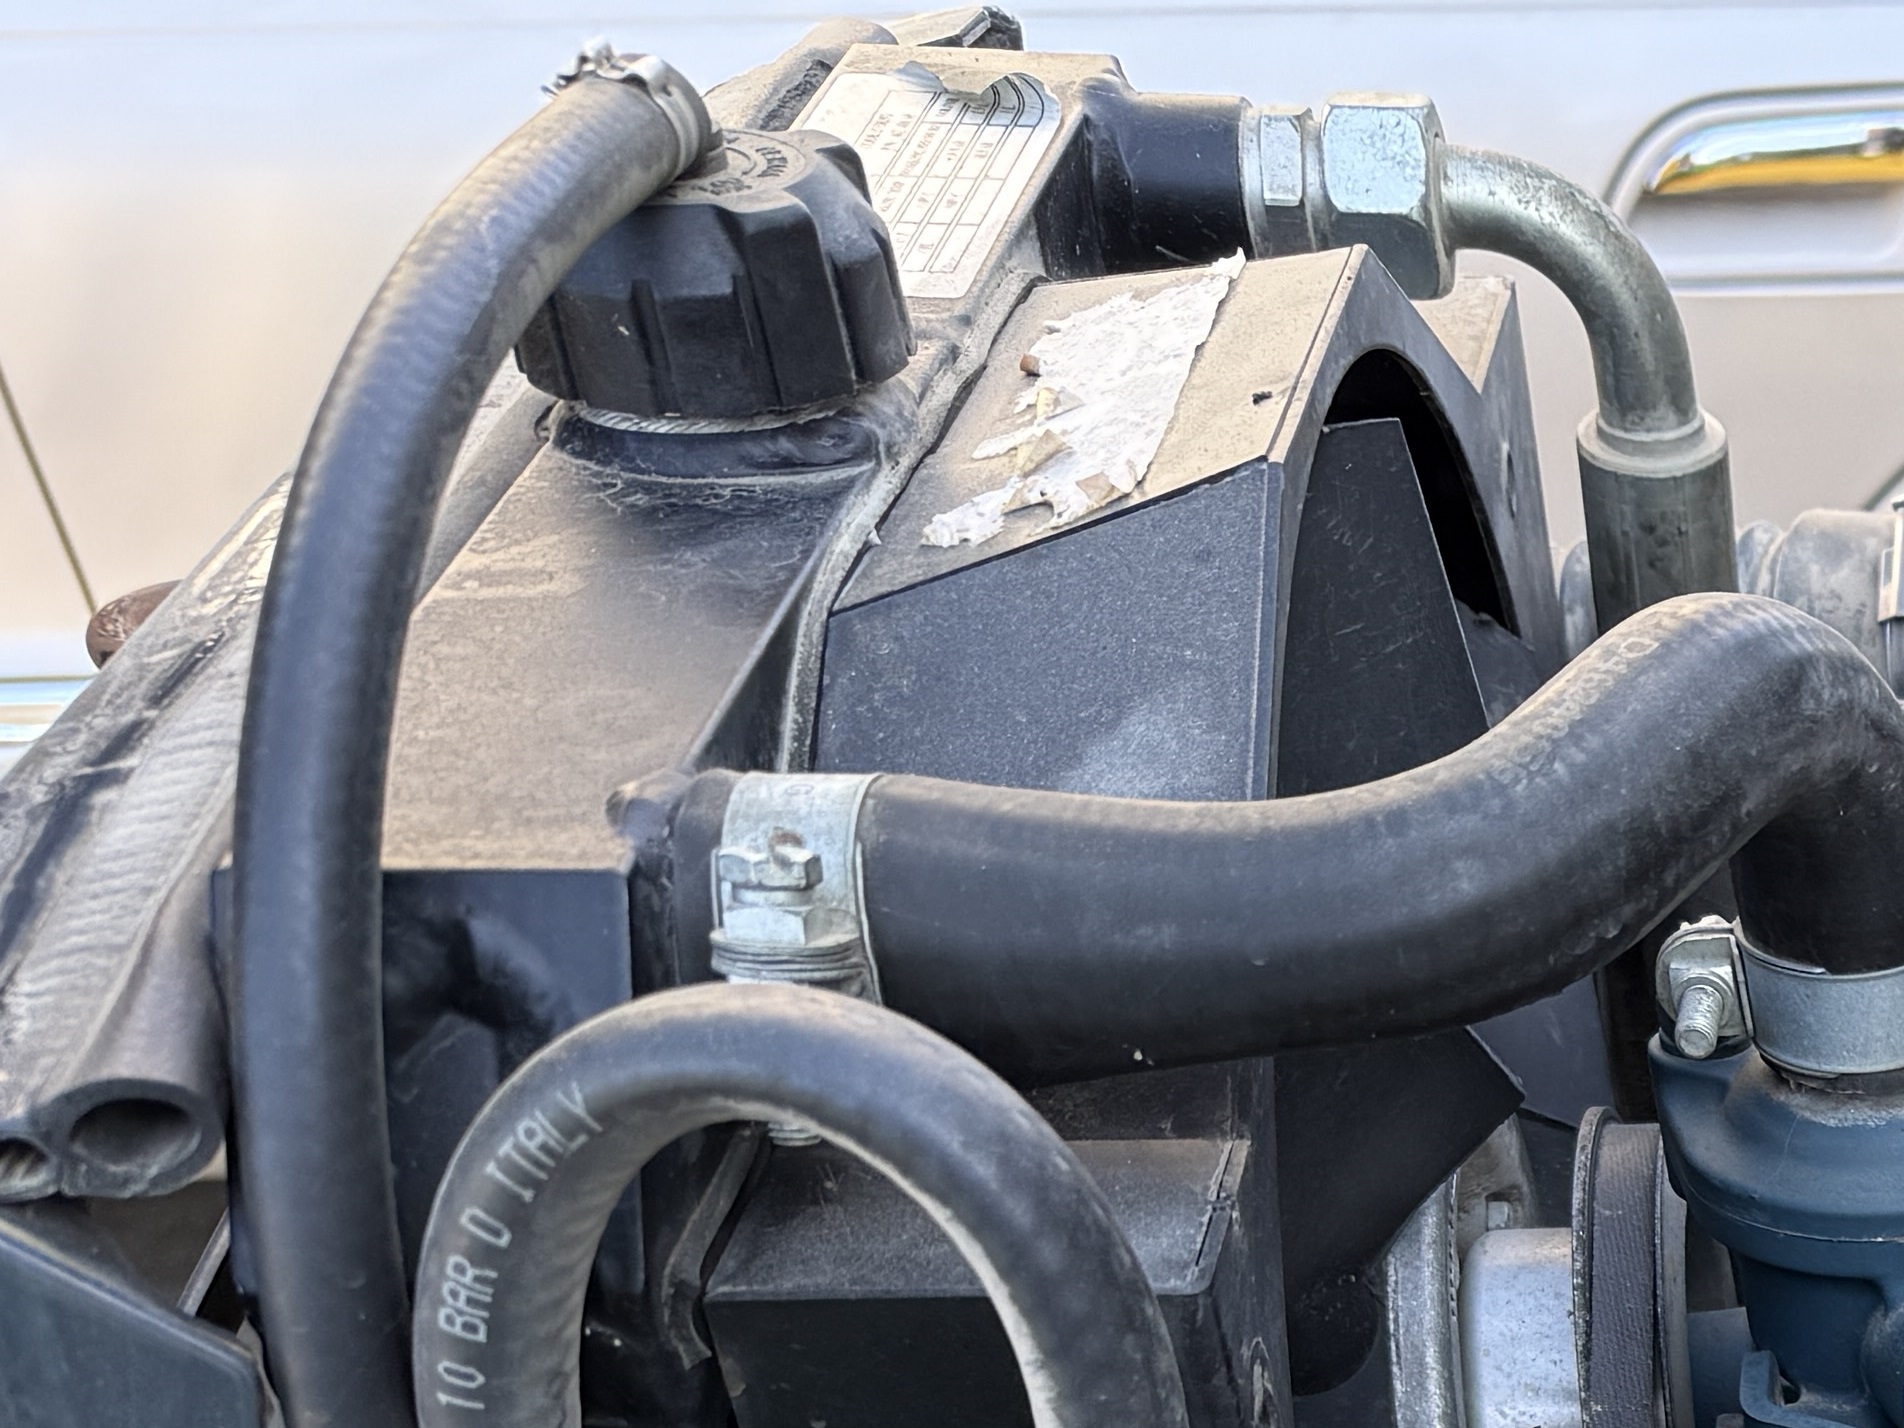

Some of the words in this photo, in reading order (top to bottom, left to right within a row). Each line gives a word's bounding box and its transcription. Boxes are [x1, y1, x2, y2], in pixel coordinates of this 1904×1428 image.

[483, 1080, 604, 1203] ITALY
[437, 1254, 498, 1343] BAR
[436, 1360, 486, 1411] 10
